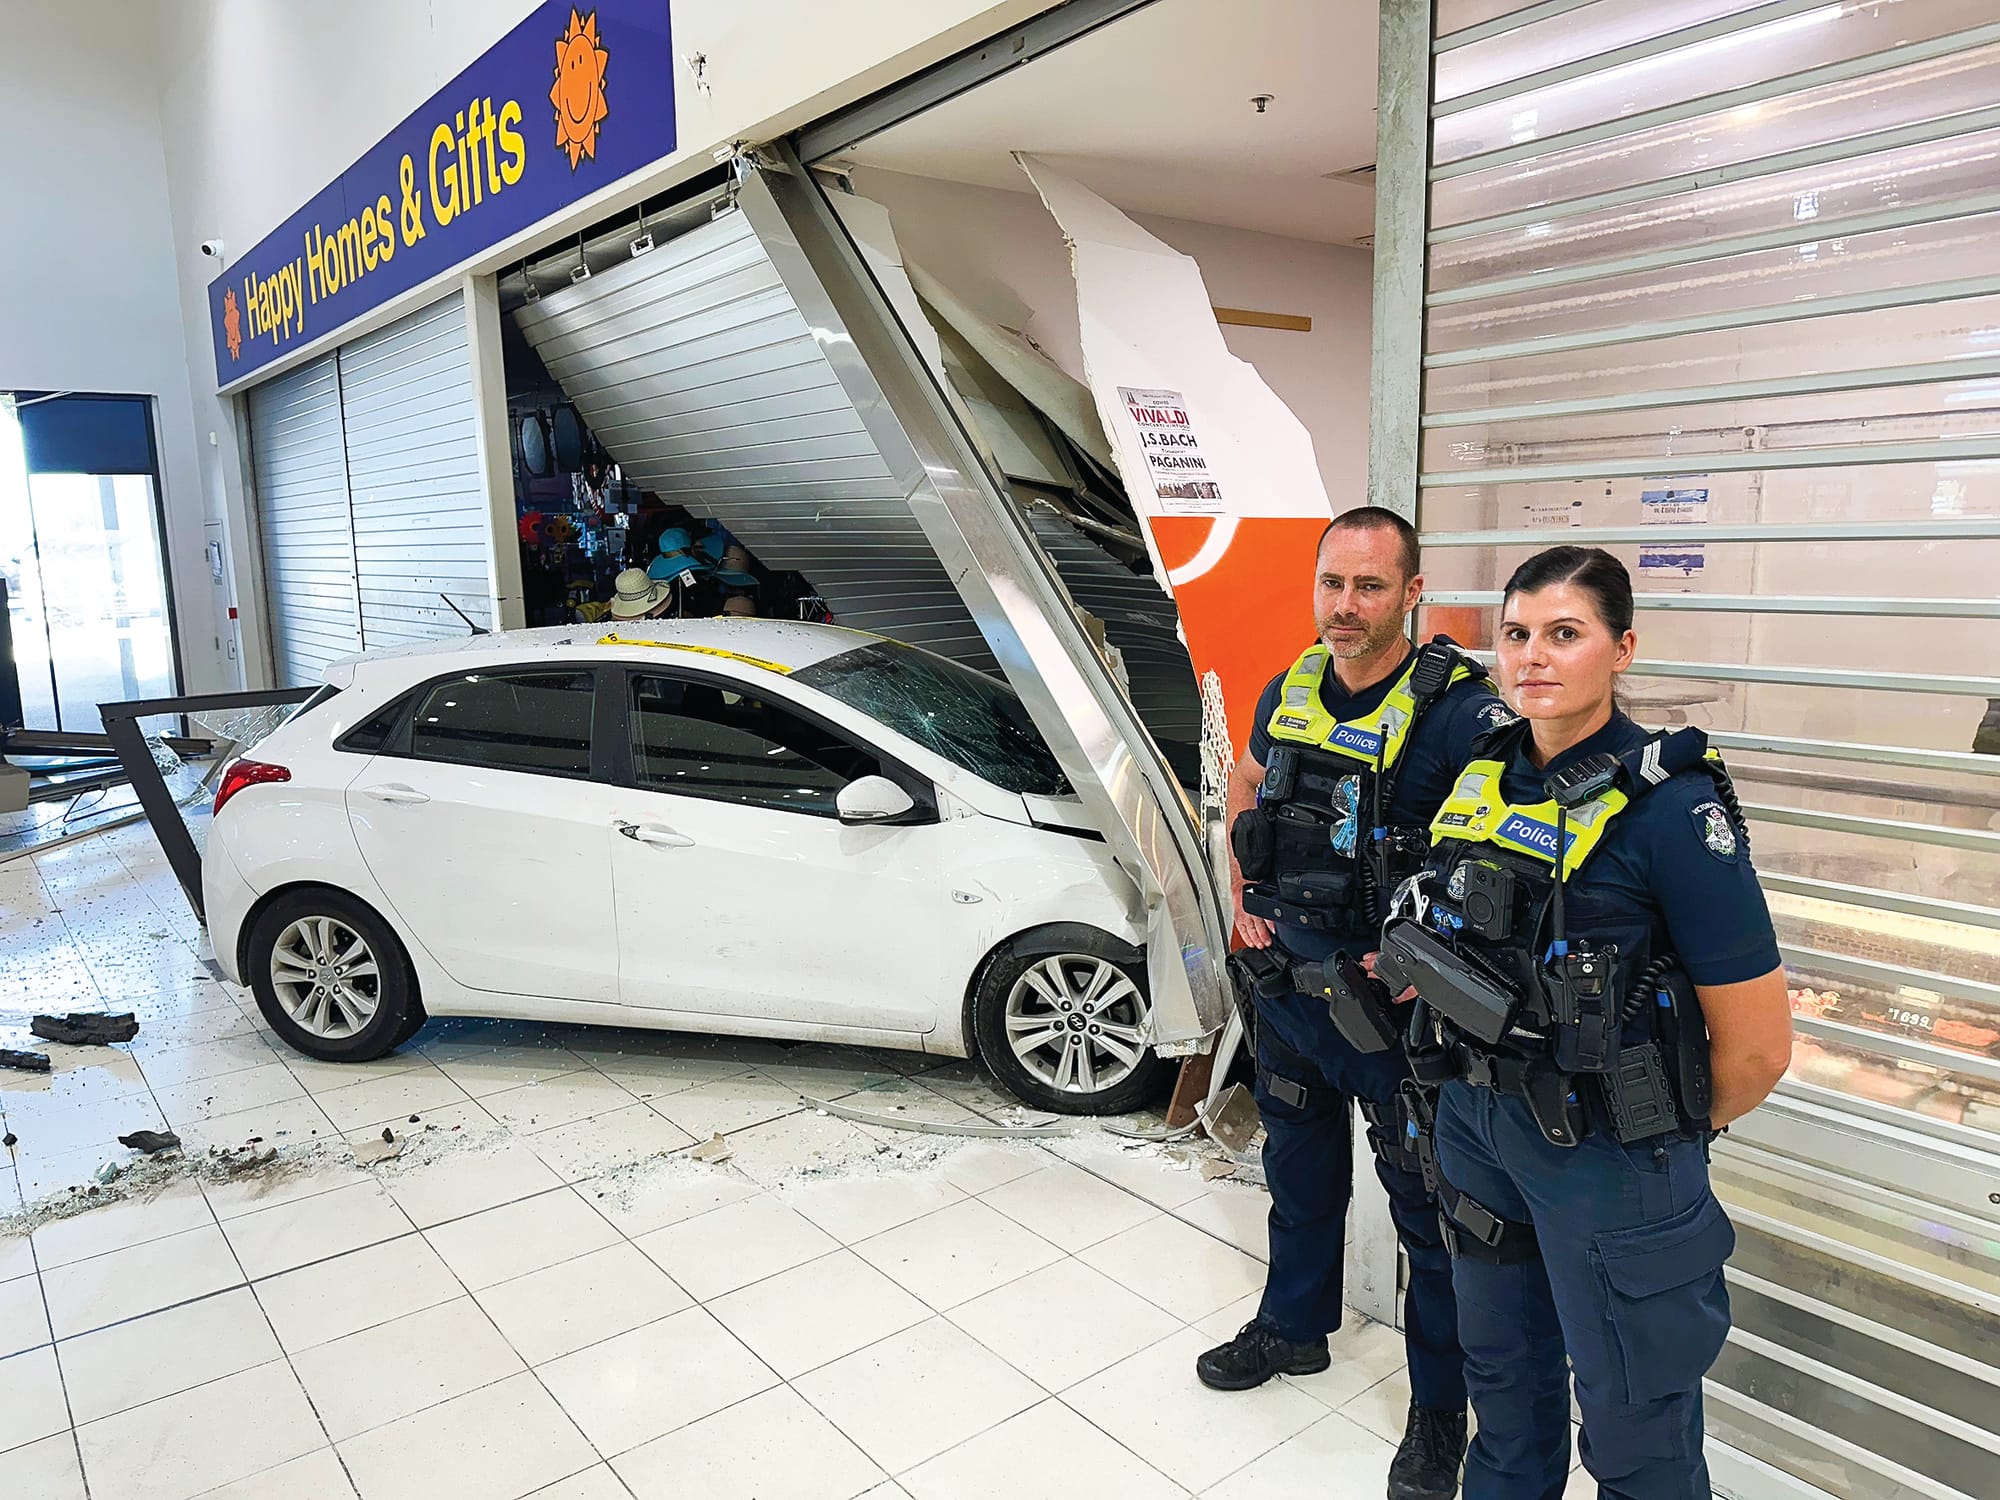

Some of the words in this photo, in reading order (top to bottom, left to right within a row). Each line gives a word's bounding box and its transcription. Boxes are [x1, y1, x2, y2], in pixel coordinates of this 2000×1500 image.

[243, 256, 304, 345] Happy
[305, 195, 395, 304] Homes
[399, 154, 427, 248] &
[428, 97, 526, 227] Gifts
[1129, 407, 1190, 425] VIVALDI
[1140, 431, 1198, 448] J.S.BACH
[1149, 455, 1207, 469] PAGANINI
[1336, 729, 1378, 750] Police
[1506, 819, 1558, 851] Police
